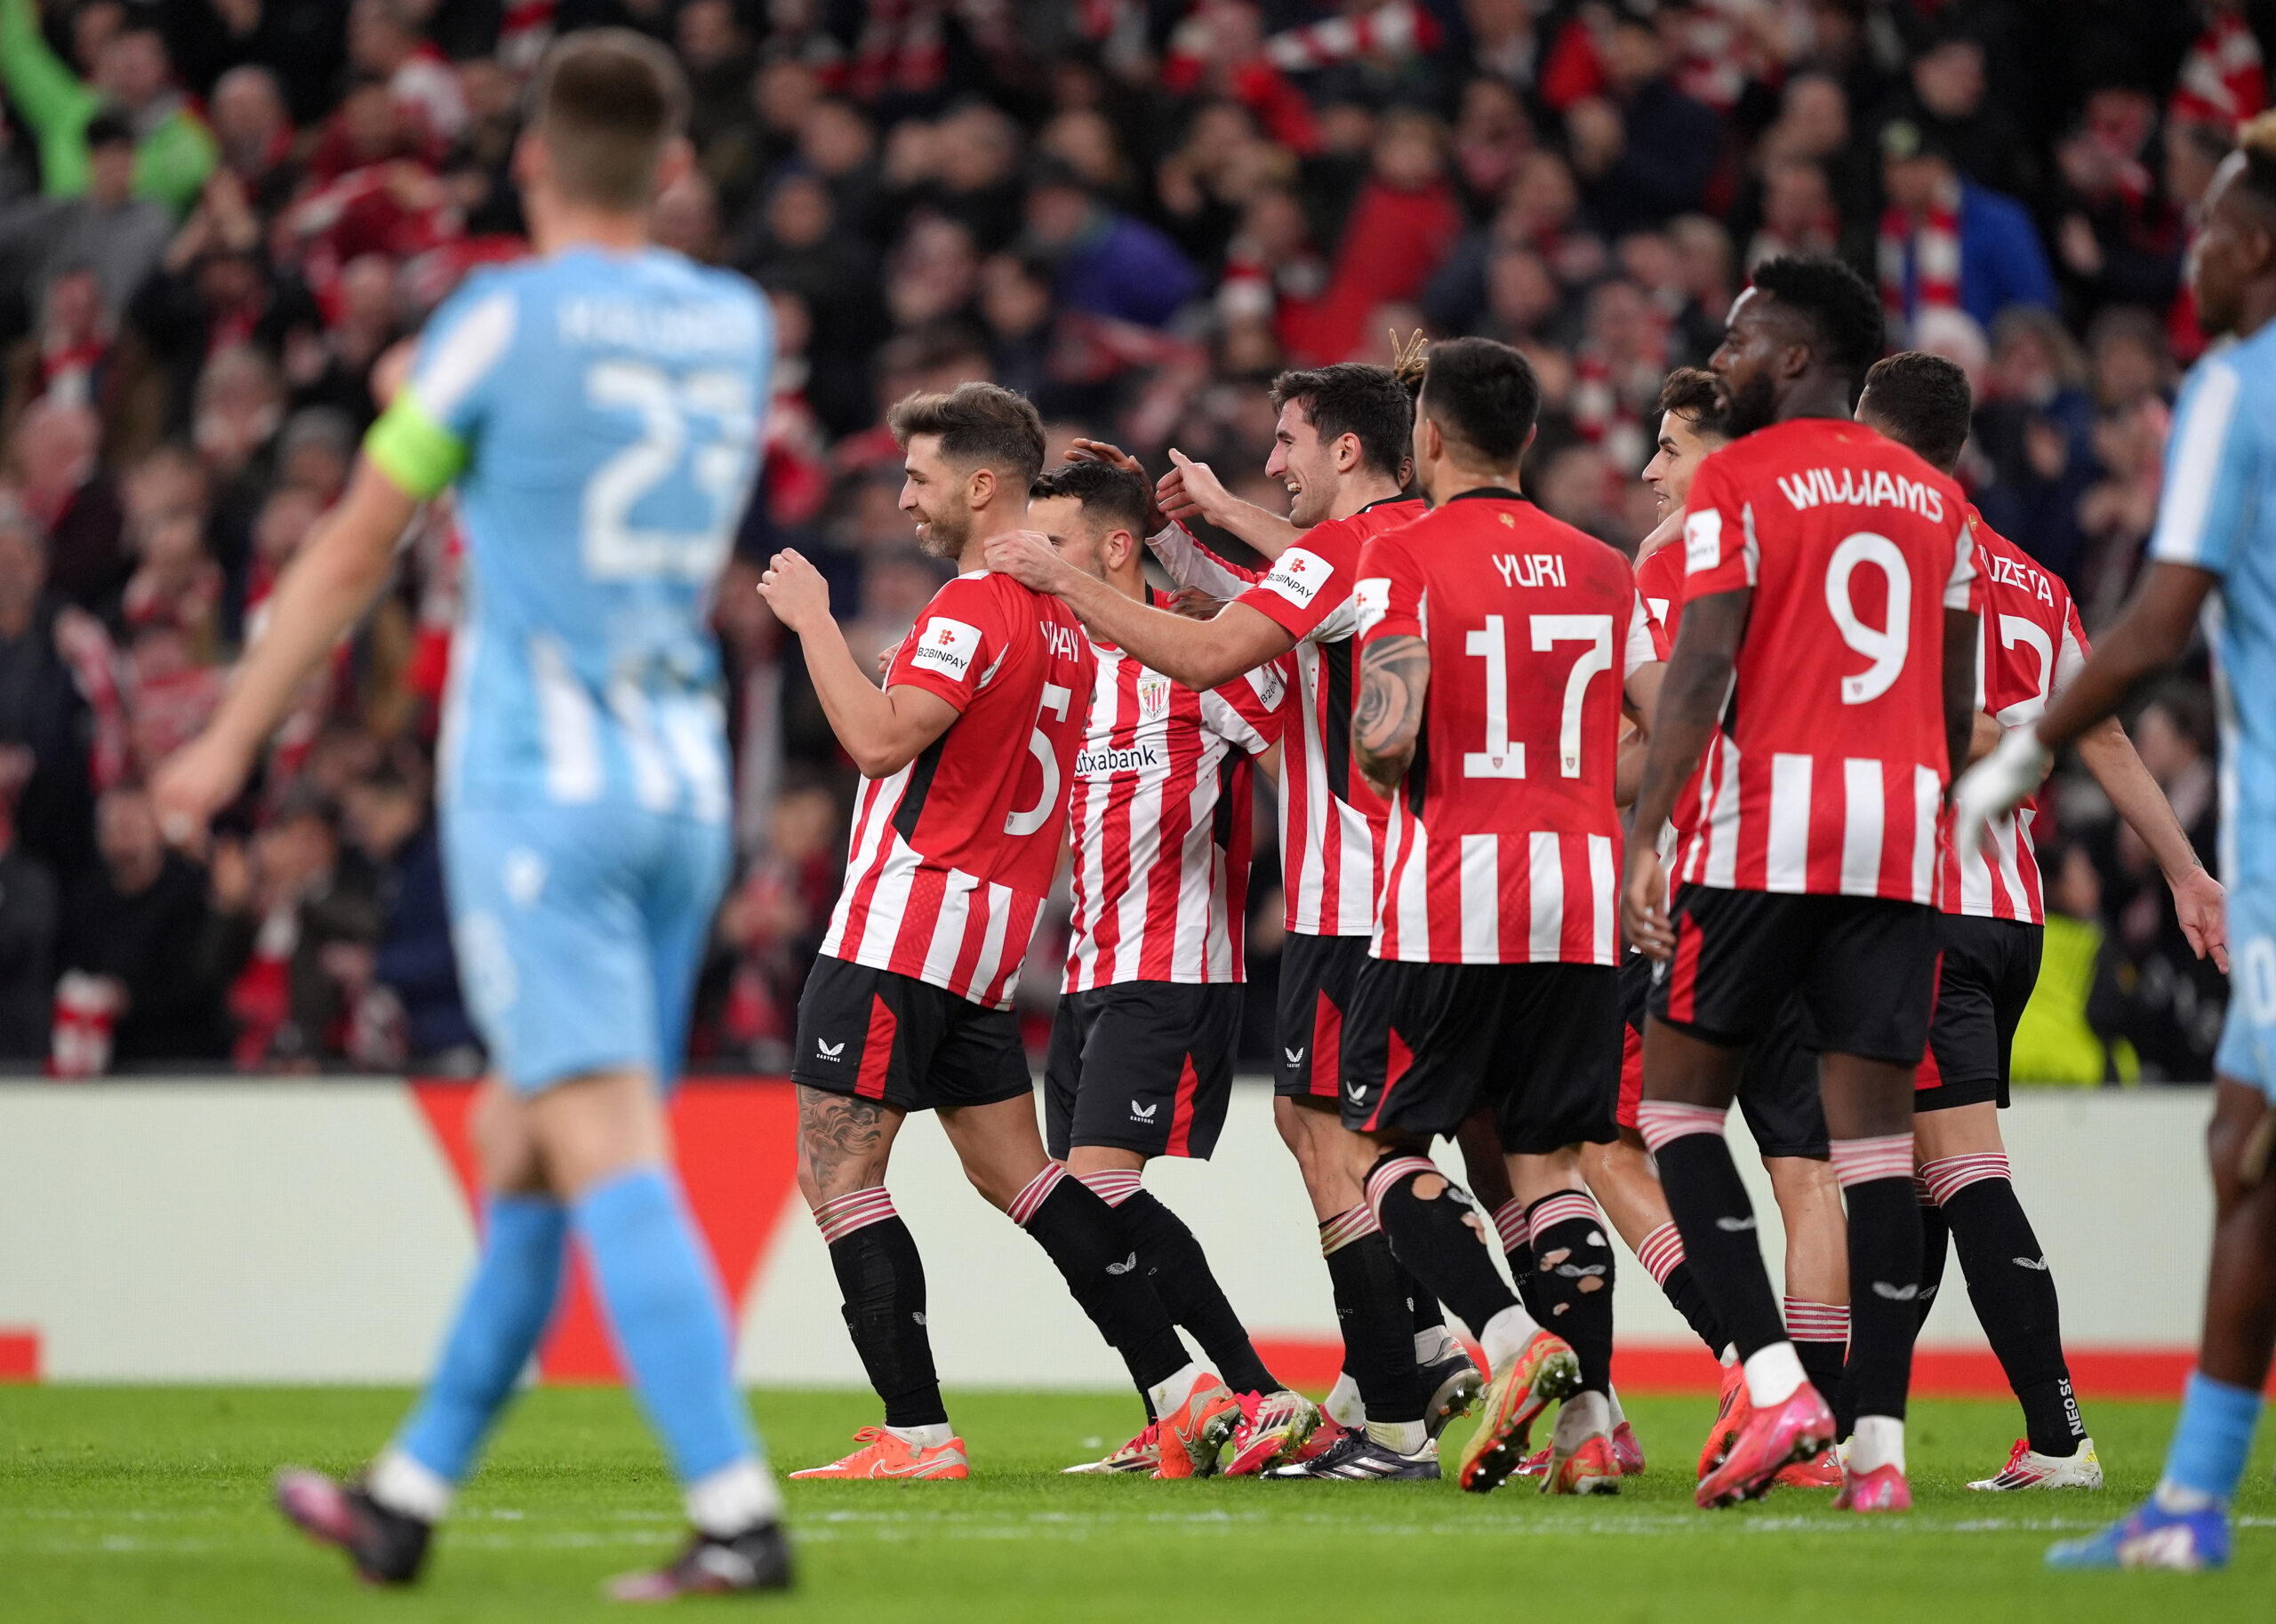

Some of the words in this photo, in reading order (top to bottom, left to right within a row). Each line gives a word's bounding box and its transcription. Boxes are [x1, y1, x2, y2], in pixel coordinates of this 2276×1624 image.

[1777, 468, 1943, 524] WILLIAMS
[1266, 573, 1313, 598] B2BINPAY
[1492, 555, 1567, 587] YURI
[1825, 532, 1911, 705] 9
[917, 646, 968, 669] B2BINPAY
[1463, 614, 1614, 780] 17
[1004, 681, 1072, 836] 5
[816, 1053, 841, 1063] CASTORE
